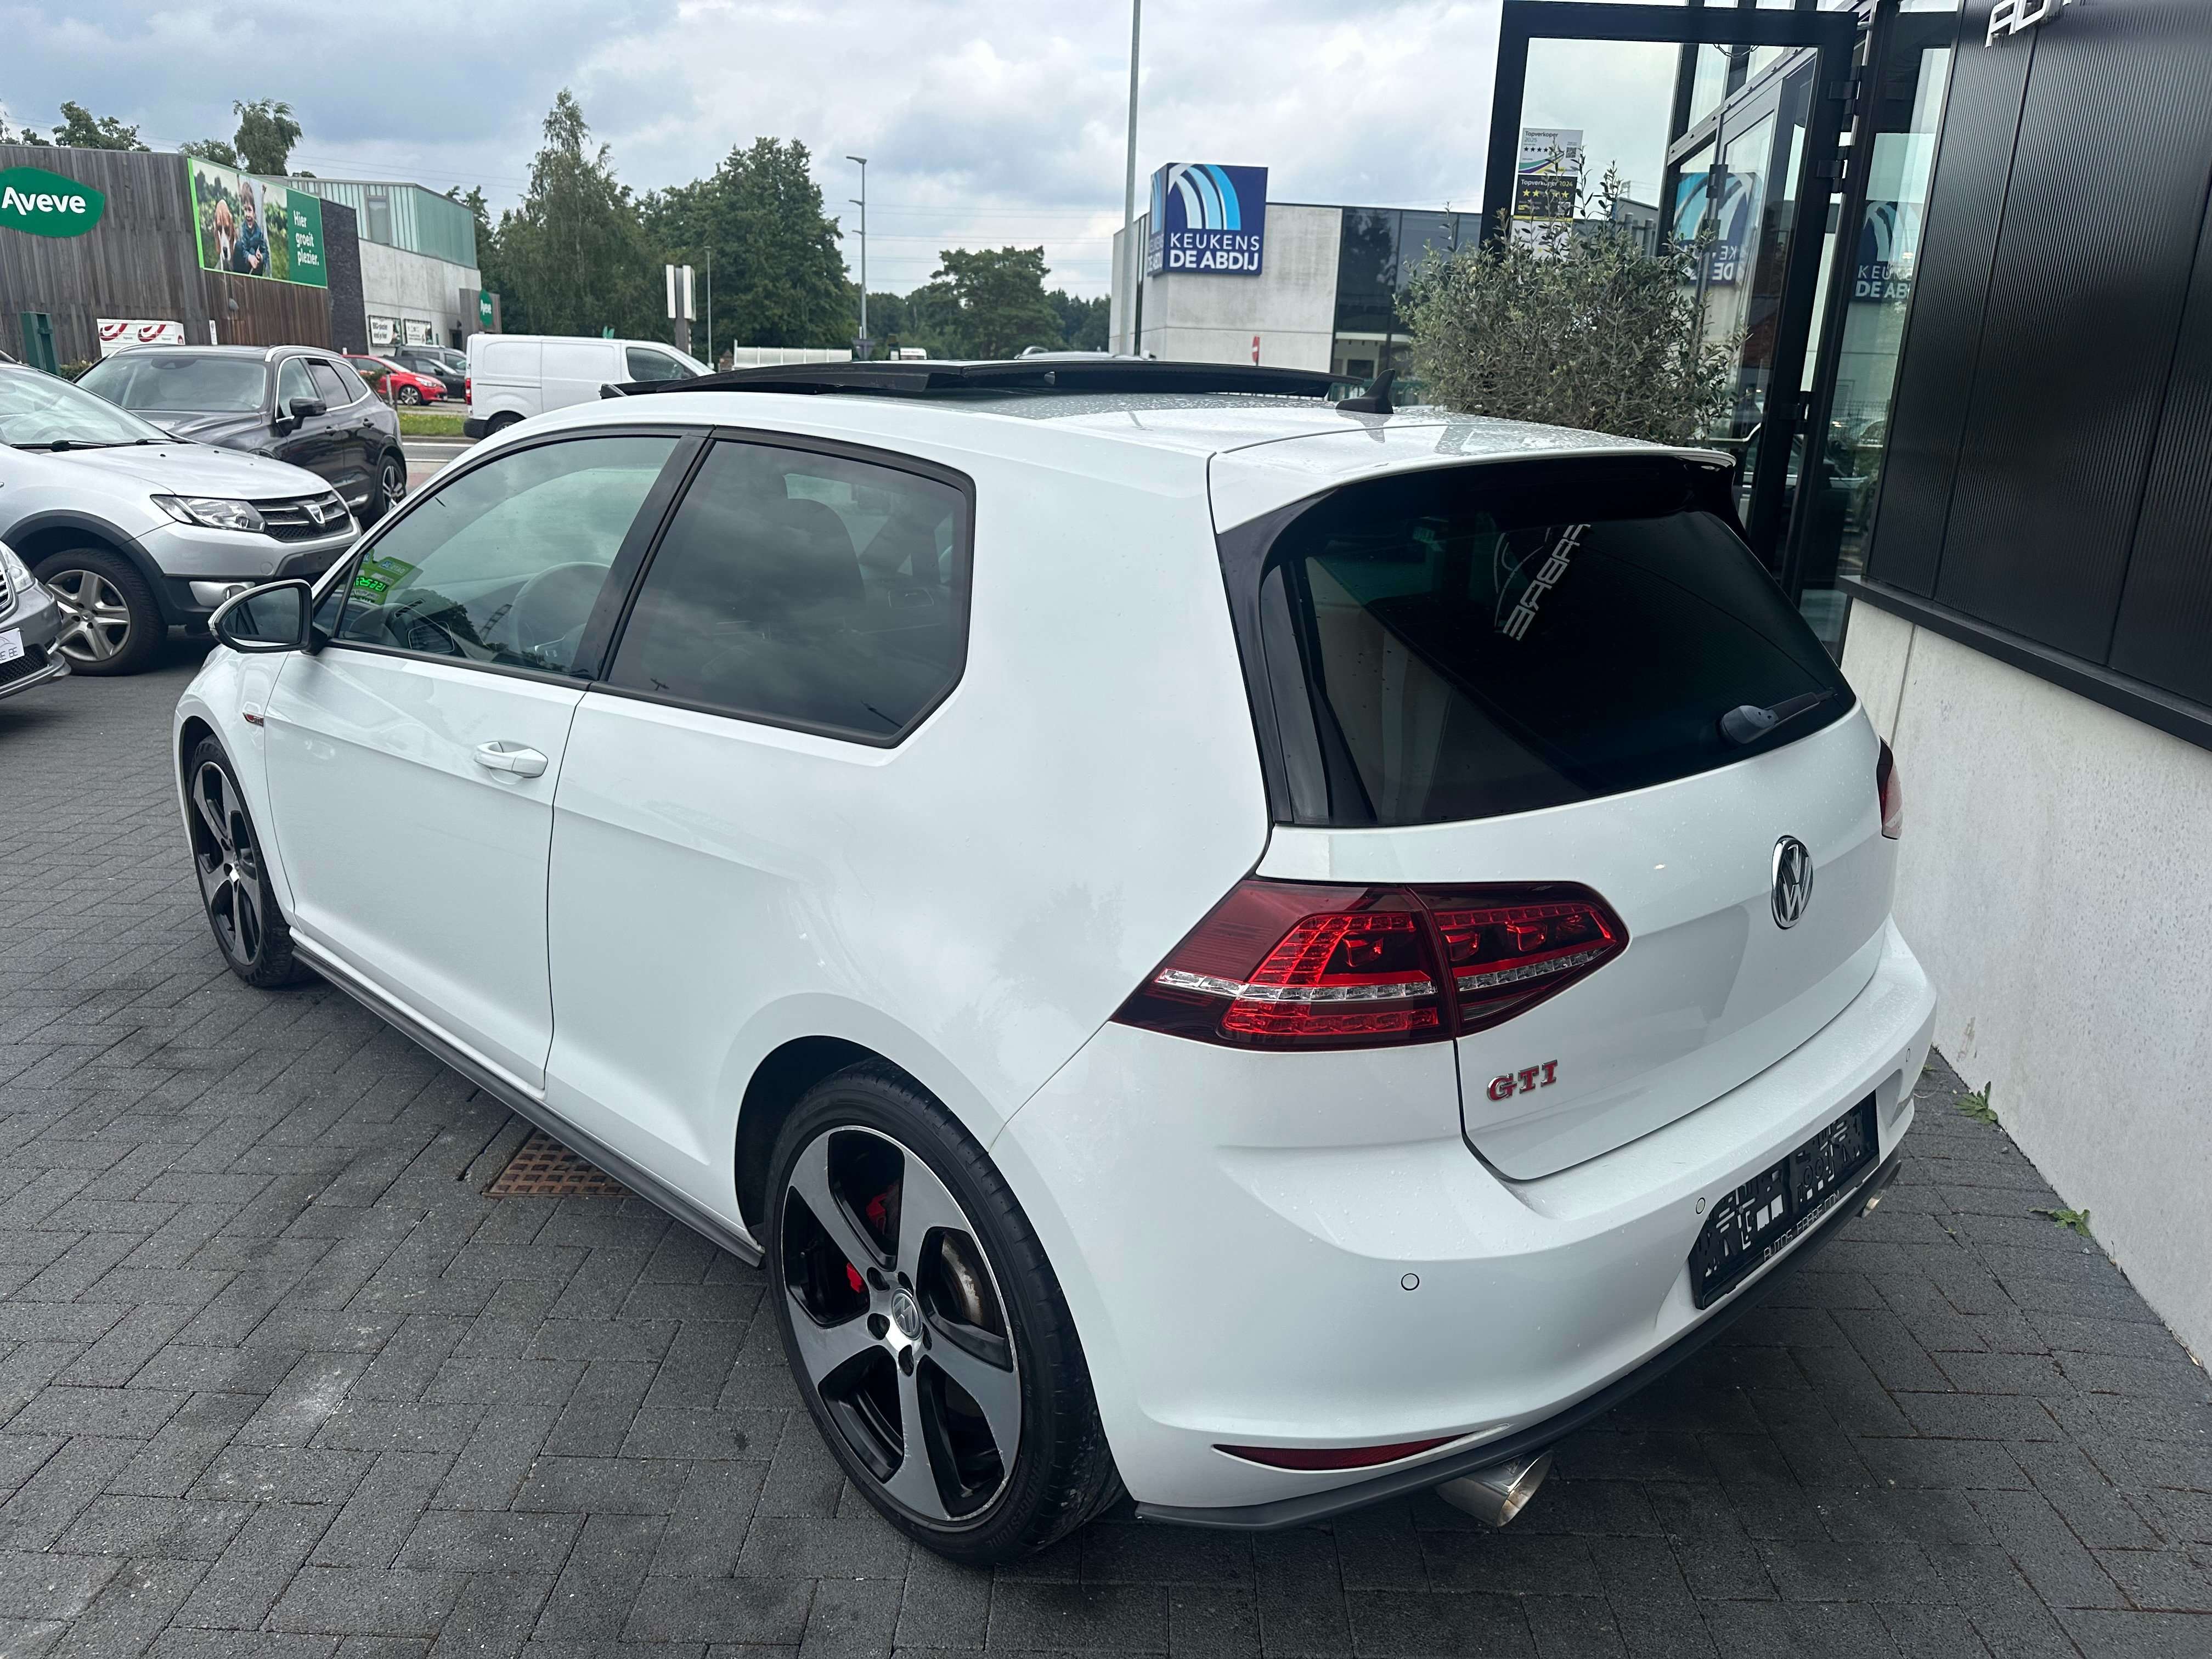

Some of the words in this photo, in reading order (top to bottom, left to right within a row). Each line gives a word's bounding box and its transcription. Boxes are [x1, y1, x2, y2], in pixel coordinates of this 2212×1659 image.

[2, 187, 86, 216] Aveve
[293, 210, 307, 228] Hier
[295, 232, 314, 248] groeit
[1170, 233, 1260, 251] KEUKENS
[297, 247, 319, 266] plezier.
[1169, 250, 1198, 268] DE
[1199, 251, 1259, 271] ABDIJ
[1855, 280, 1882, 298] DE
[1883, 283, 1911, 299] AB
[1487, 1059, 1558, 1102] GTI
[1764, 1228, 1793, 1262] AUTOS
